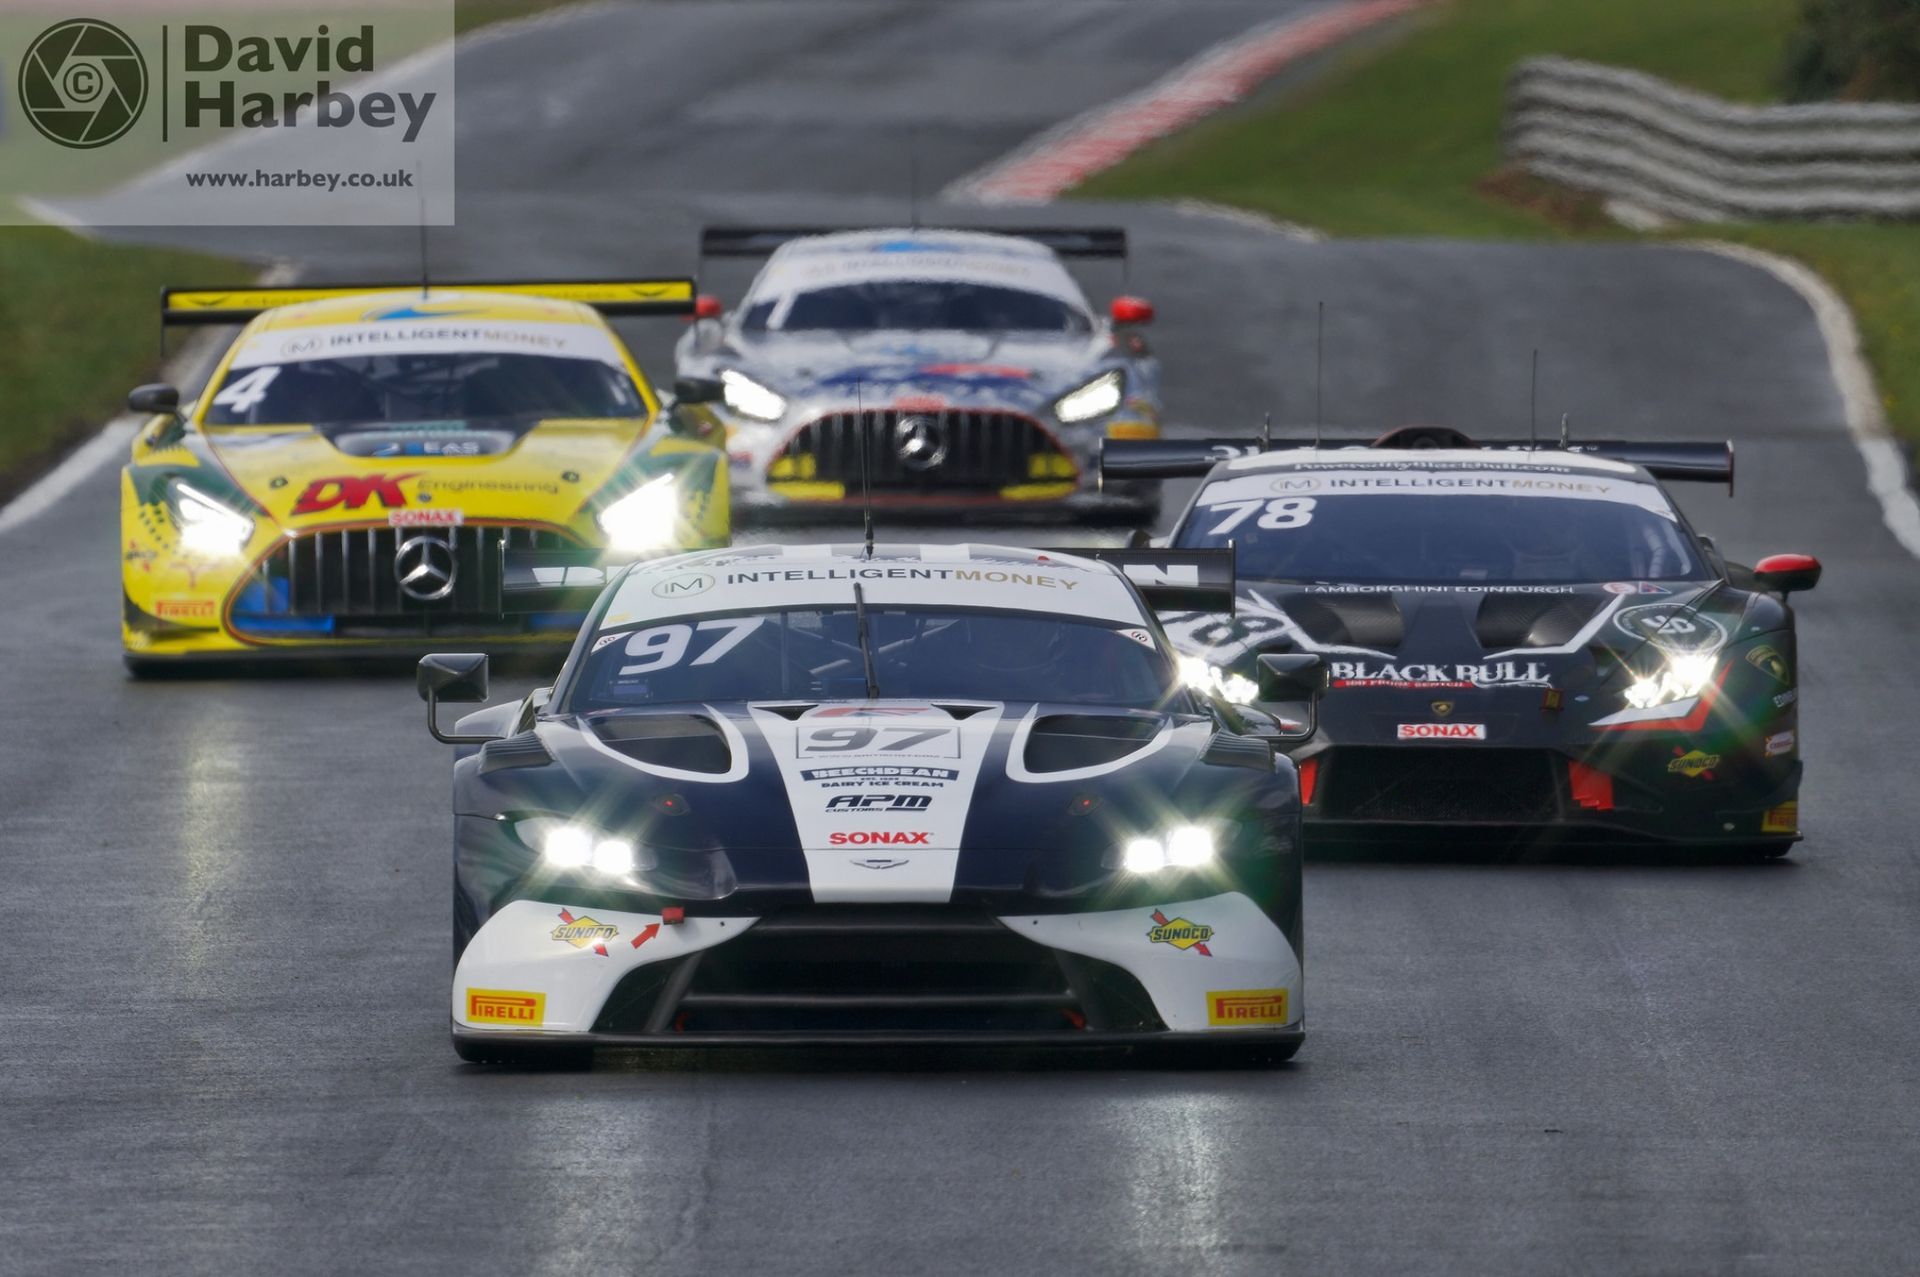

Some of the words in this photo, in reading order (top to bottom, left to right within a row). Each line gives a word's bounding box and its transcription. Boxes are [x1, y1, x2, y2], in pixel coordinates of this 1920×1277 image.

[330, 327, 567, 349] INTELLIGENTMONEY
[213, 365, 281, 413] 4
[289, 473, 428, 517] DK
[1329, 478, 1612, 494] INTELLIGENTMONEY
[391, 510, 458, 523] SONAX
[1207, 496, 1318, 536] 78
[727, 568, 1079, 591] INTELLIGENTMONEY
[1304, 585, 1448, 594] LAMBORGHINI
[1454, 585, 1574, 594] EDINBURGH
[618, 616, 766, 676] 97
[1331, 661, 1451, 682] BLACK
[1456, 661, 1551, 687] BULL
[804, 726, 953, 752] 97
[1400, 724, 1478, 738] SONAX
[812, 766, 950, 779] BEECHDEAN
[1671, 755, 1719, 770] SUNOCO
[829, 831, 930, 845] SONAX
[555, 925, 615, 940] SUNOCO
[1153, 926, 1212, 941] SUNOCO
[471, 994, 537, 1021] PIRELLI
[1215, 994, 1283, 1020] PIRELLI
